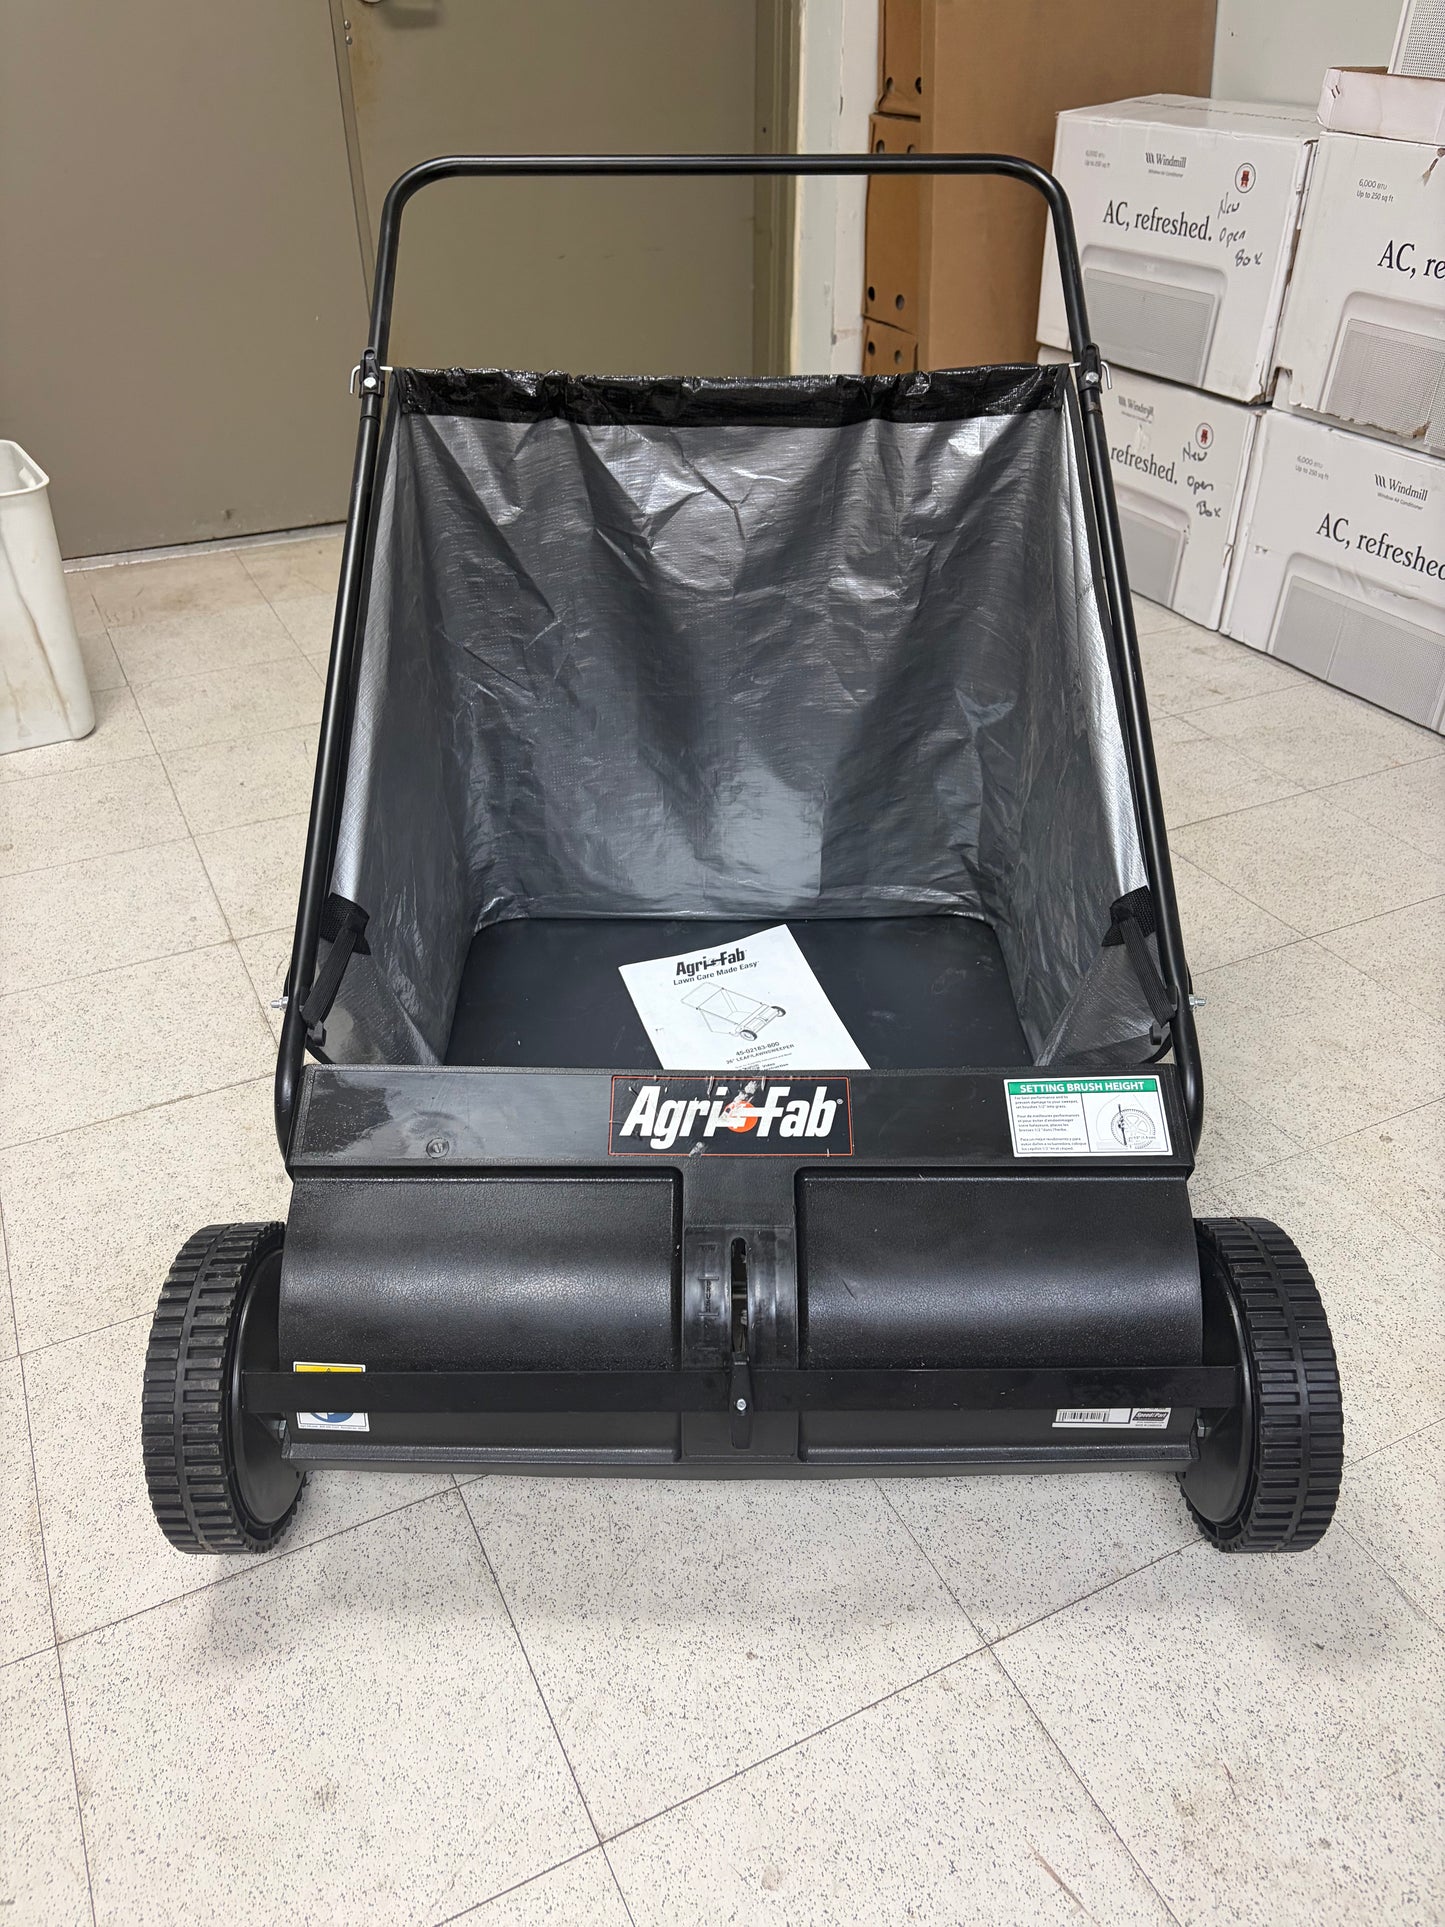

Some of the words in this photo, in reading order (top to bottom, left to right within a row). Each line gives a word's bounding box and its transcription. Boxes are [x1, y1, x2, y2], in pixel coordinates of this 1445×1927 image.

[1358, 178, 1376, 189] 6,000
[1356, 190, 1364, 199] Up
[1365, 191, 1371, 199] to
[1371, 192, 1381, 201] 250
[1381, 195, 1388, 203] sq
[1388, 194, 1394, 202] ft
[1102, 199, 1130, 232] AC,
[1134, 206, 1212, 242] refreshed.
[1219, 227, 1247, 248] Open
[1235, 248, 1263, 268] Box
[1376, 239, 1416, 280] AC,
[1182, 441, 1208, 462] New
[1110, 444, 1178, 485] refreshed.
[1187, 475, 1214, 495] Open
[1389, 478, 1429, 502] Windmill
[1196, 500, 1222, 518] Box
[1316, 512, 1351, 550] AC,
[673, 977, 695, 986] Lawn
[696, 972, 715, 980] Care
[716, 966, 738, 977] Made
[739, 961, 758, 971] Easy
[1019, 1082, 1065, 1094] SETTING
[1066, 1081, 1101, 1093] BRUSH
[1105, 1081, 1145, 1092] HEIGHT
